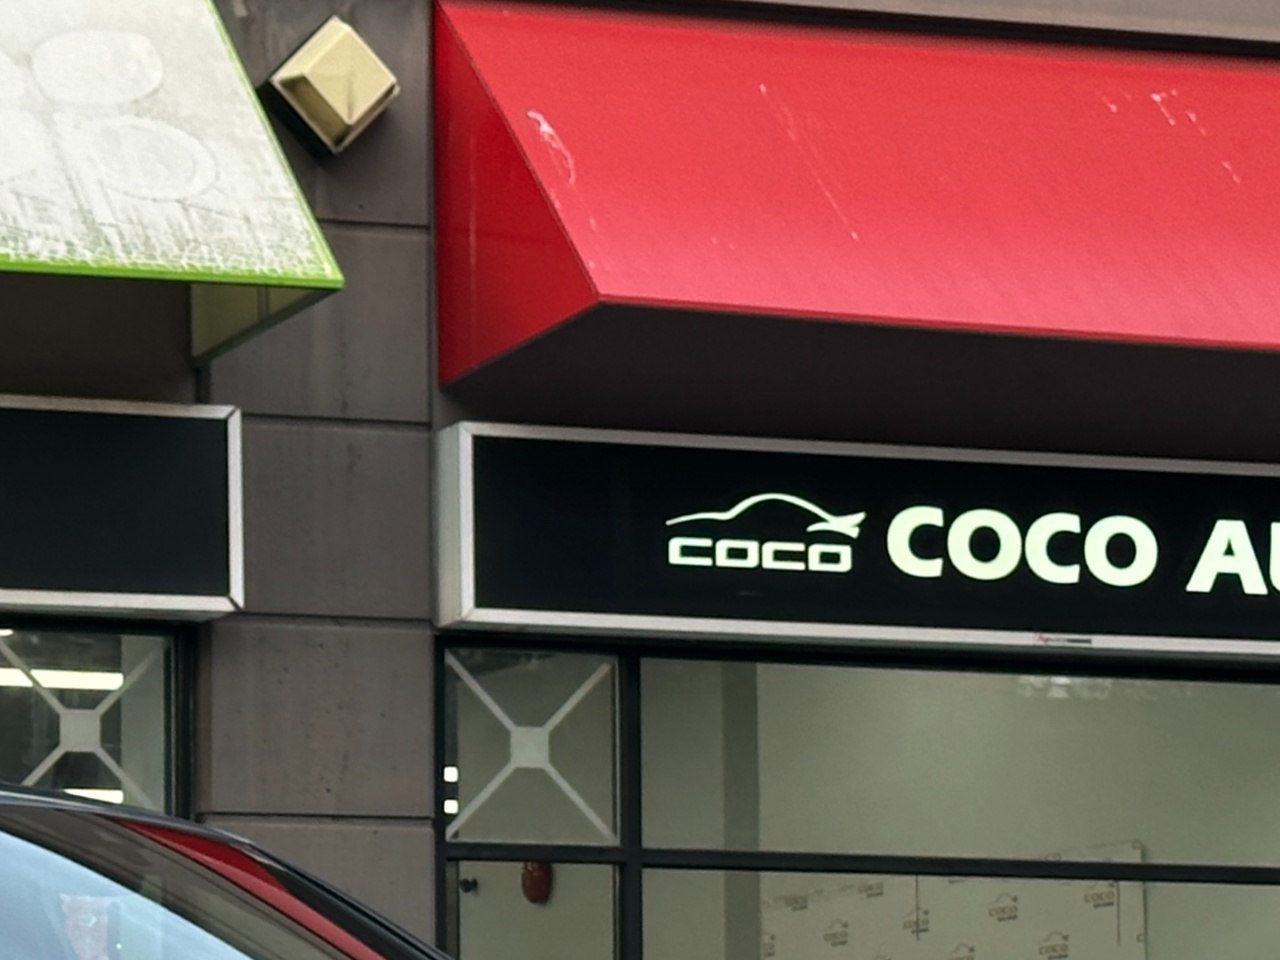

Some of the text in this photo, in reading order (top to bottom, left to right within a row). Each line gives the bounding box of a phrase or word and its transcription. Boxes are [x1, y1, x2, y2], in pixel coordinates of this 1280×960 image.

[668, 536, 852, 573] COCO
[886, 505, 1280, 595] COCO A
